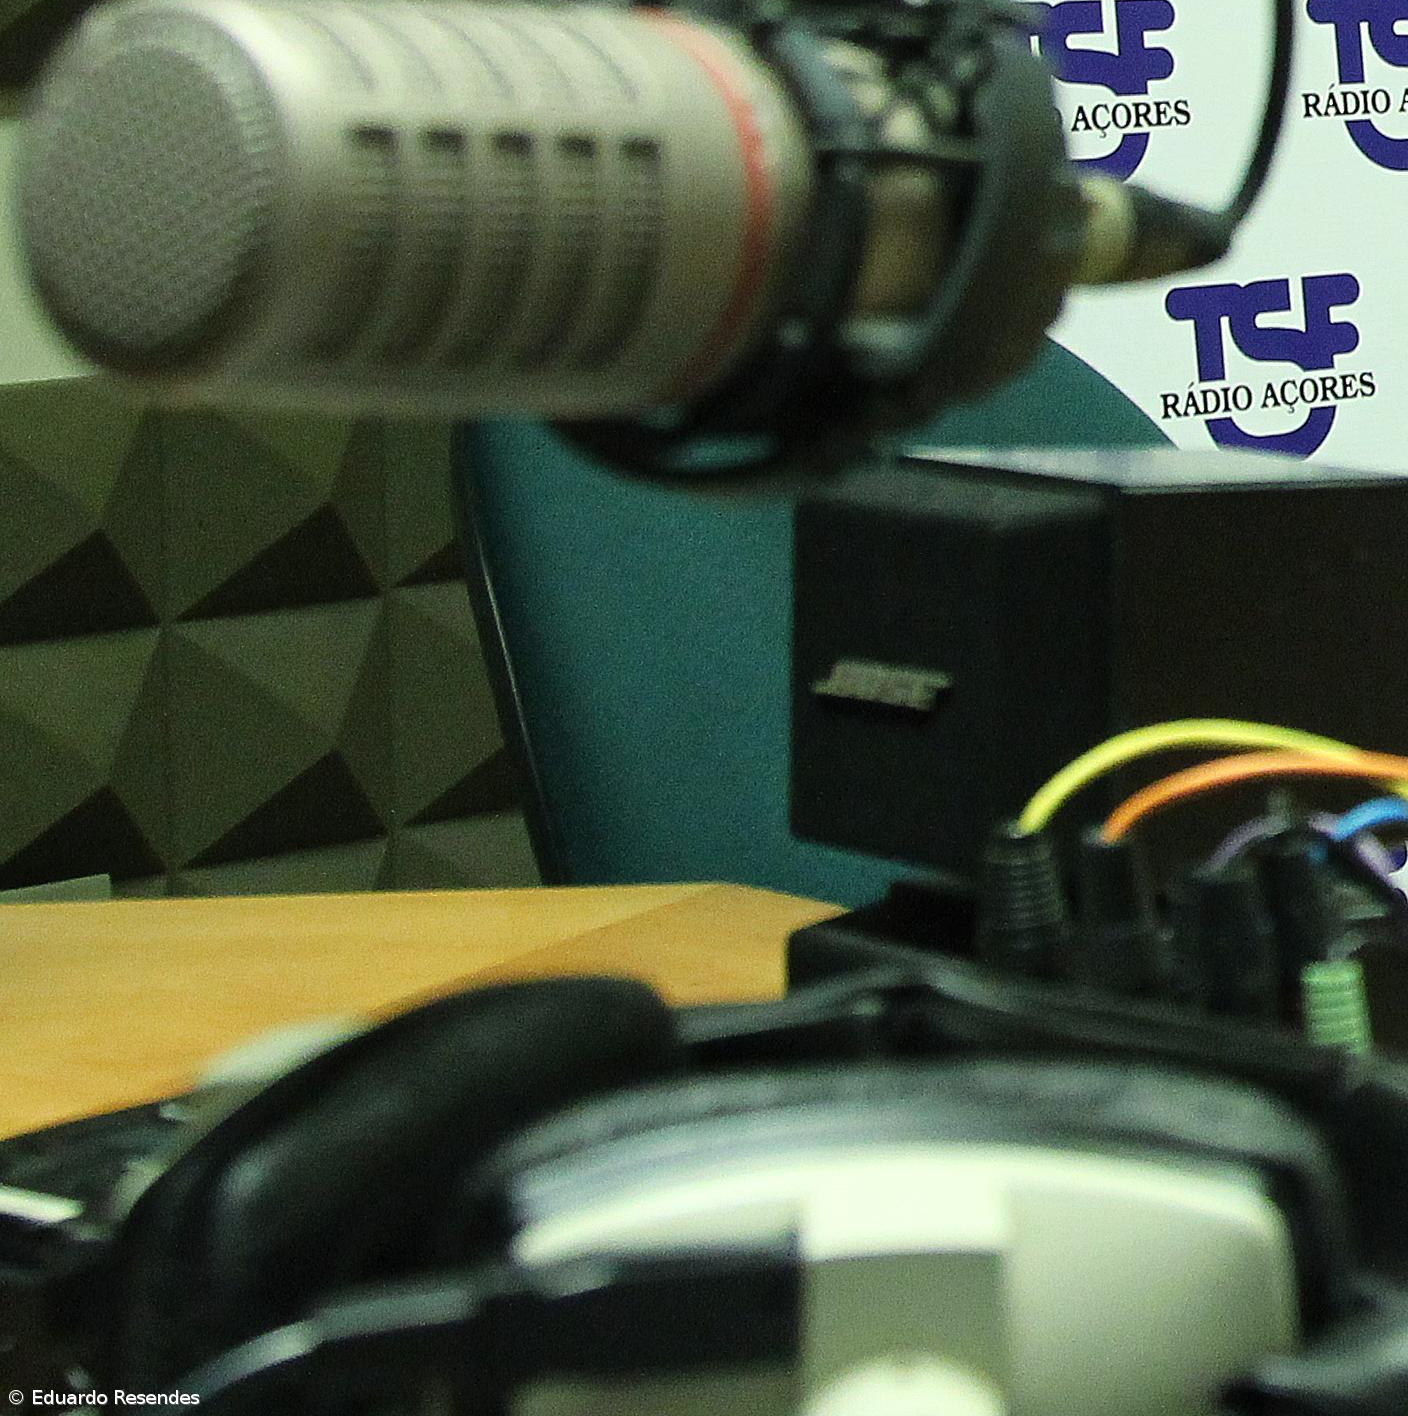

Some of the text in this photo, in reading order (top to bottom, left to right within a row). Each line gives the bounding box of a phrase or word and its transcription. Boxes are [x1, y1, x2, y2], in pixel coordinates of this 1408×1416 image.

[1070, 99, 1191, 139] AÇORES
[1302, 83, 1392, 119] RÁDIO
[1160, 372, 1376, 420] RÁDIO AÇORES
